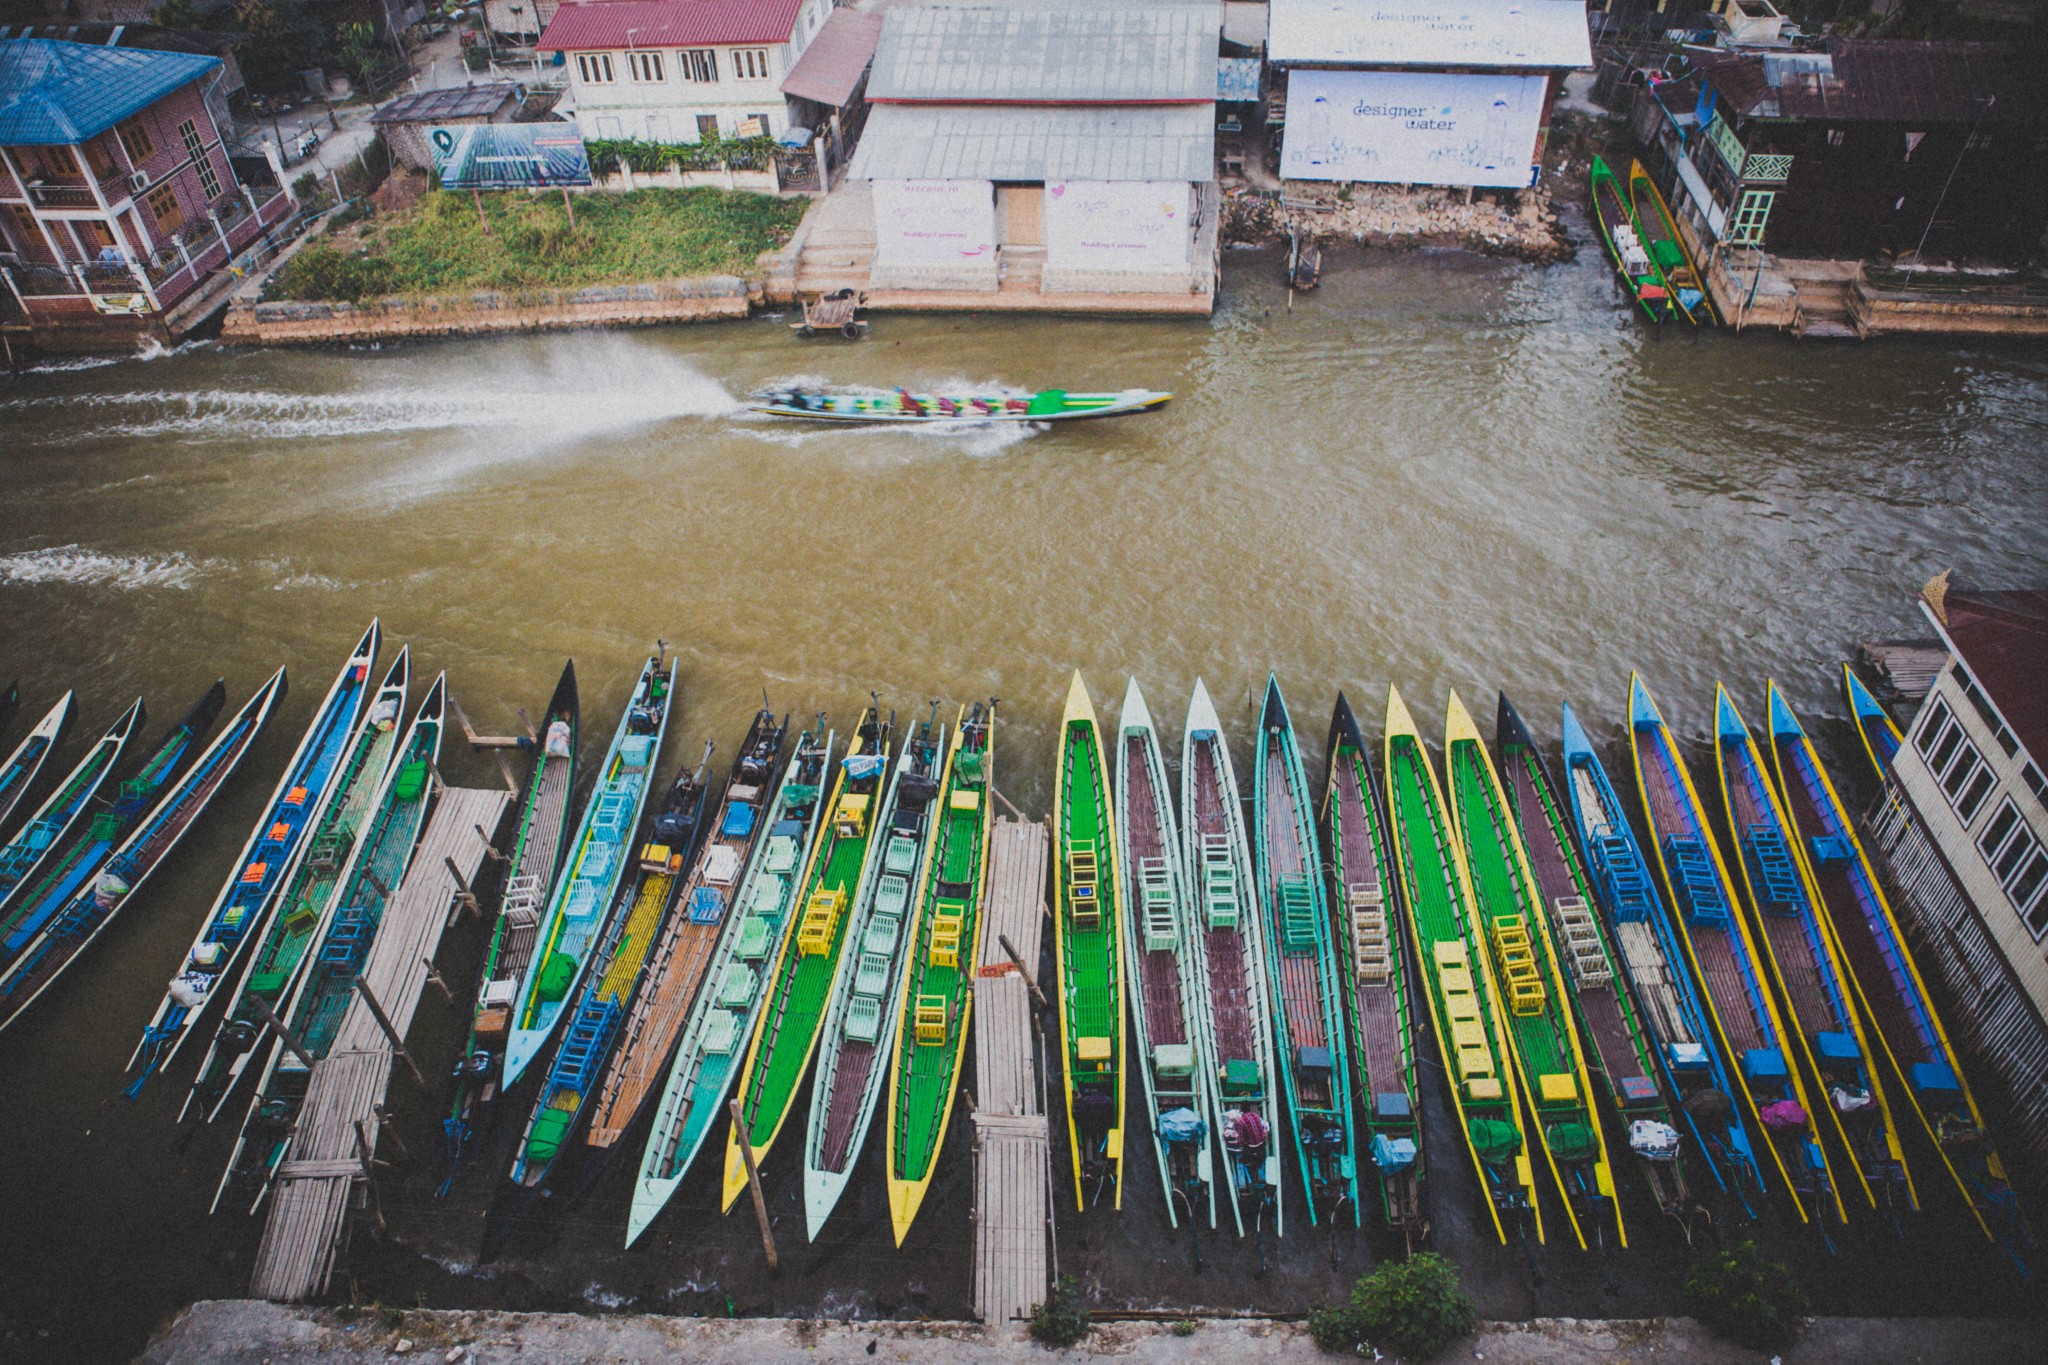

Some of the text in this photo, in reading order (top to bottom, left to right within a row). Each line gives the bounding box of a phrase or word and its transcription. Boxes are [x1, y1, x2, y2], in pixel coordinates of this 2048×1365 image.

[1371, 11, 1444, 23] designer
[1425, 23, 1476, 31] water
[1353, 99, 1428, 120] designer
[1405, 119, 1457, 131] water
[903, 231, 967, 239] Wedding Ceremony
[1081, 241, 1147, 250] Wedding Ceremony
